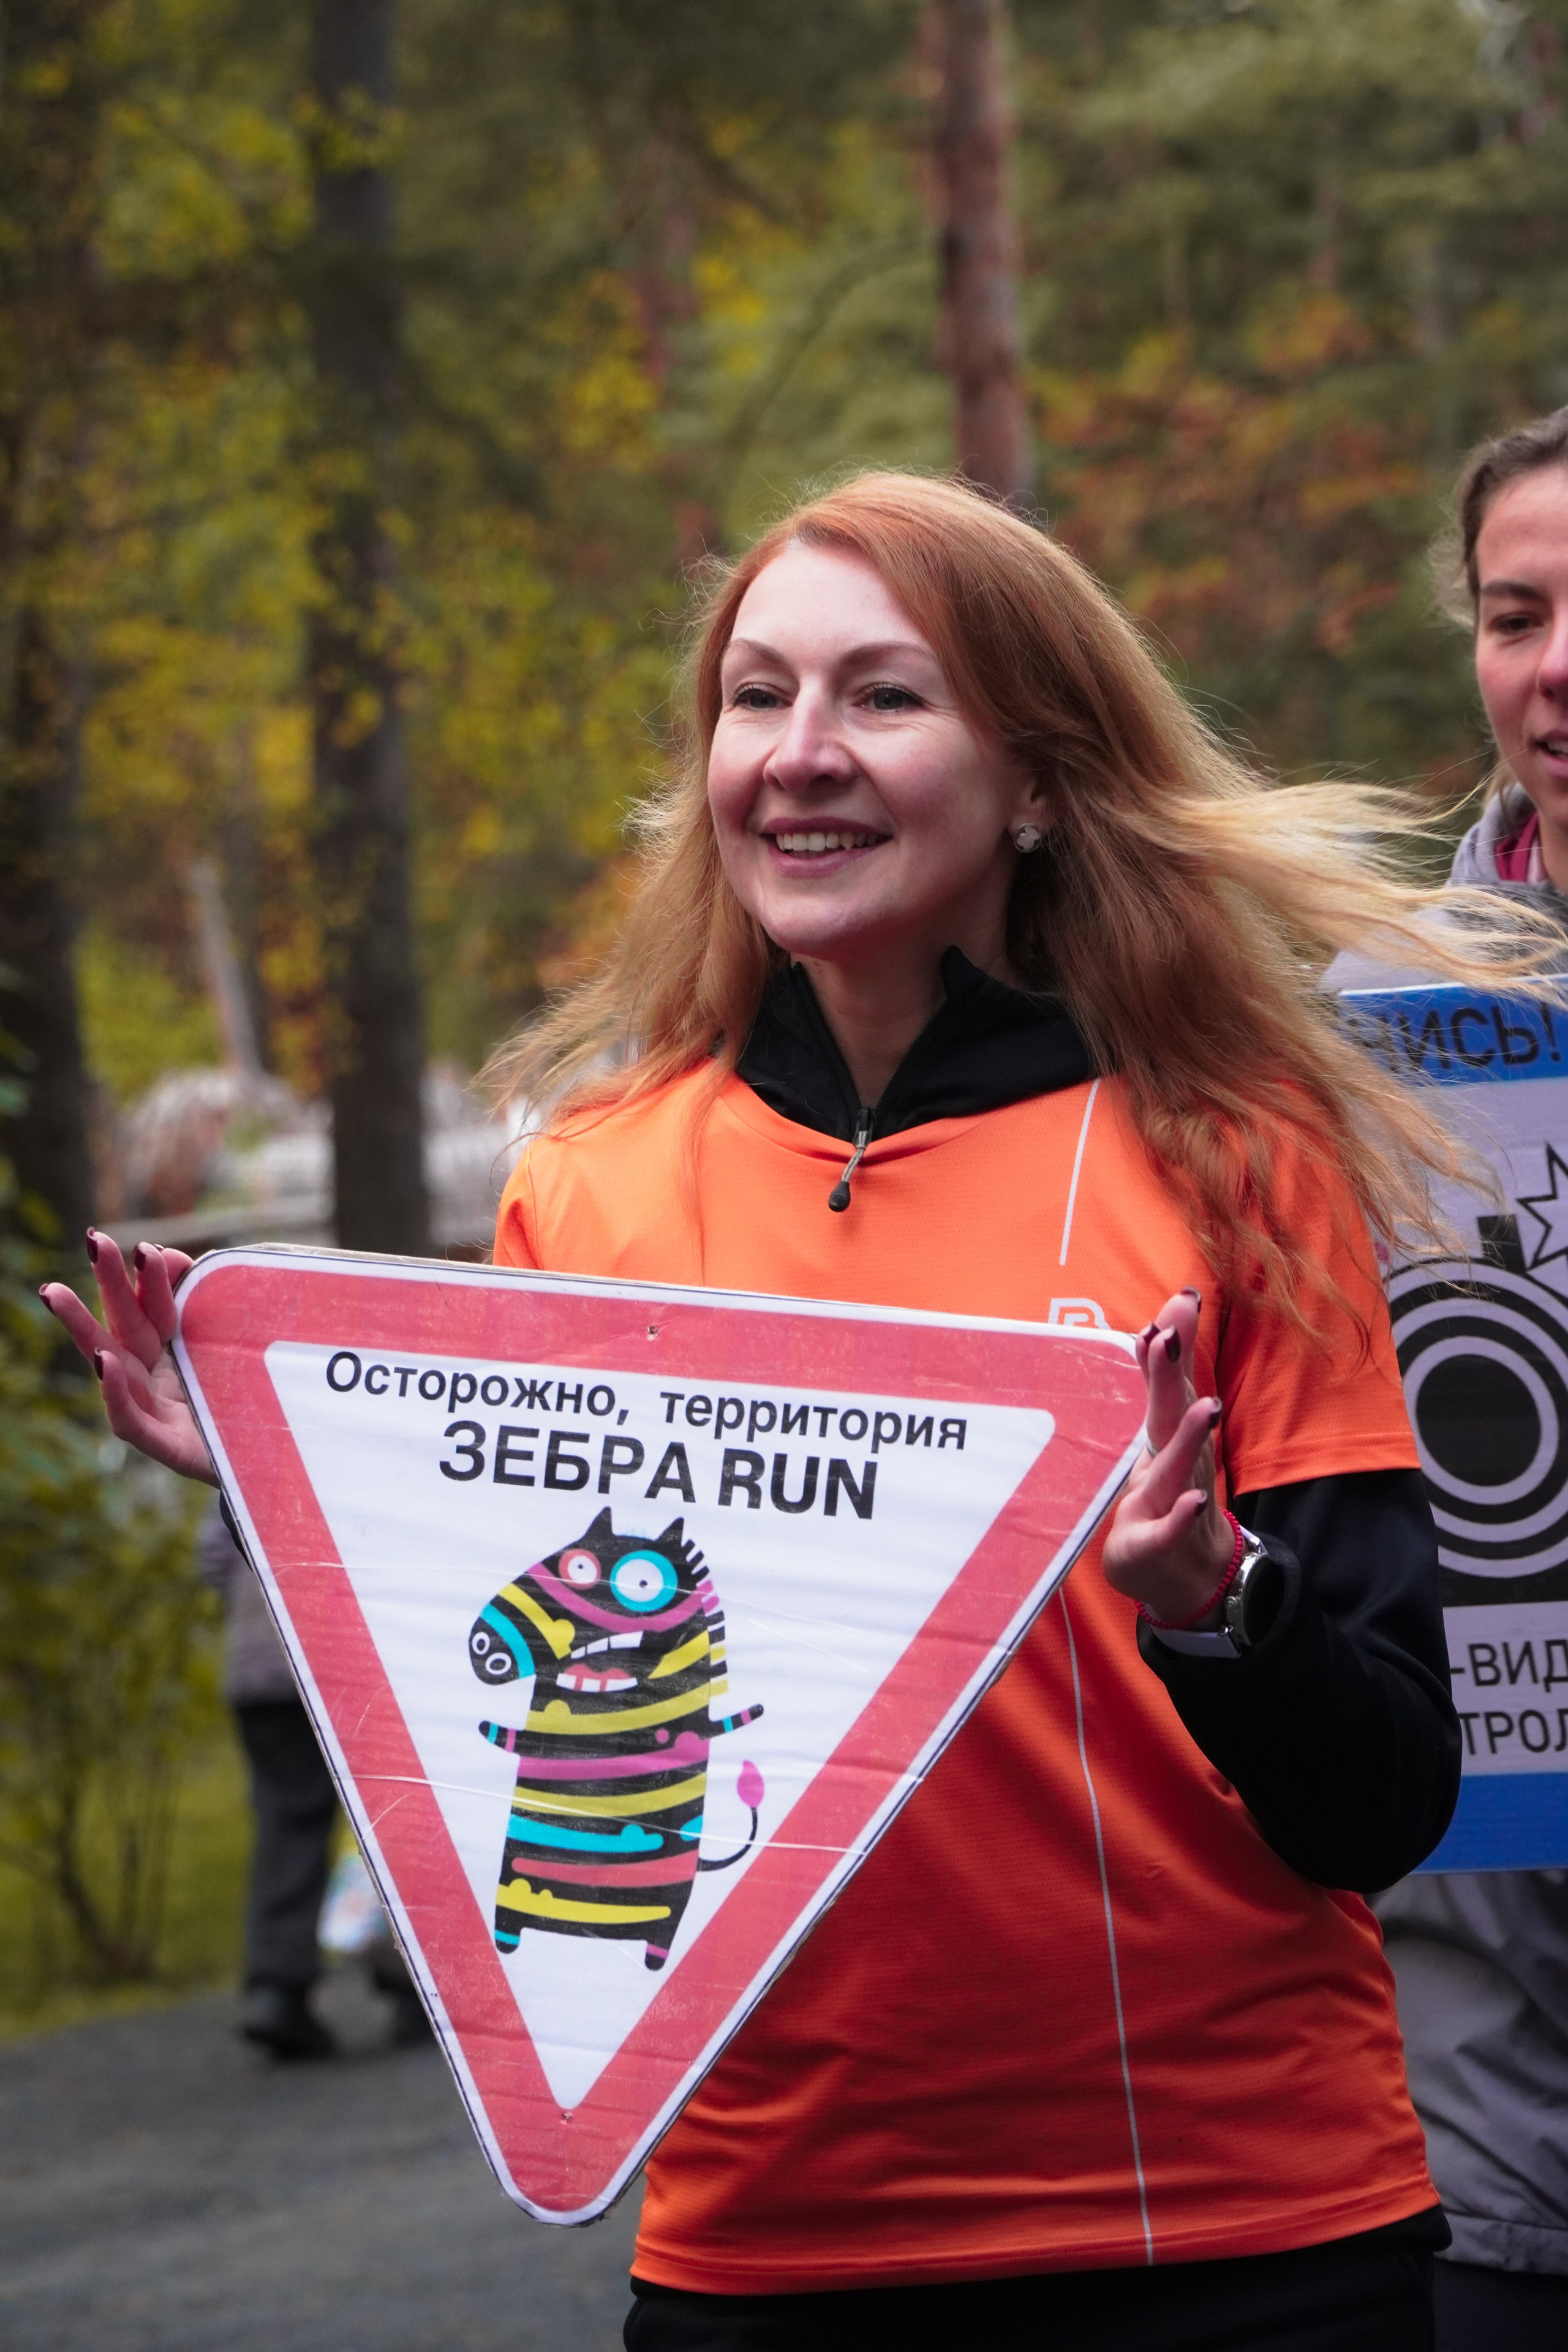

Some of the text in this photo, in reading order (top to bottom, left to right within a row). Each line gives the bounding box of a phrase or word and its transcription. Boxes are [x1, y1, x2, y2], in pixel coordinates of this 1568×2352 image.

[325, 1351, 968, 1452] Осторожно, территория
[437, 1420, 879, 1520] ЗЕБРА RUN
